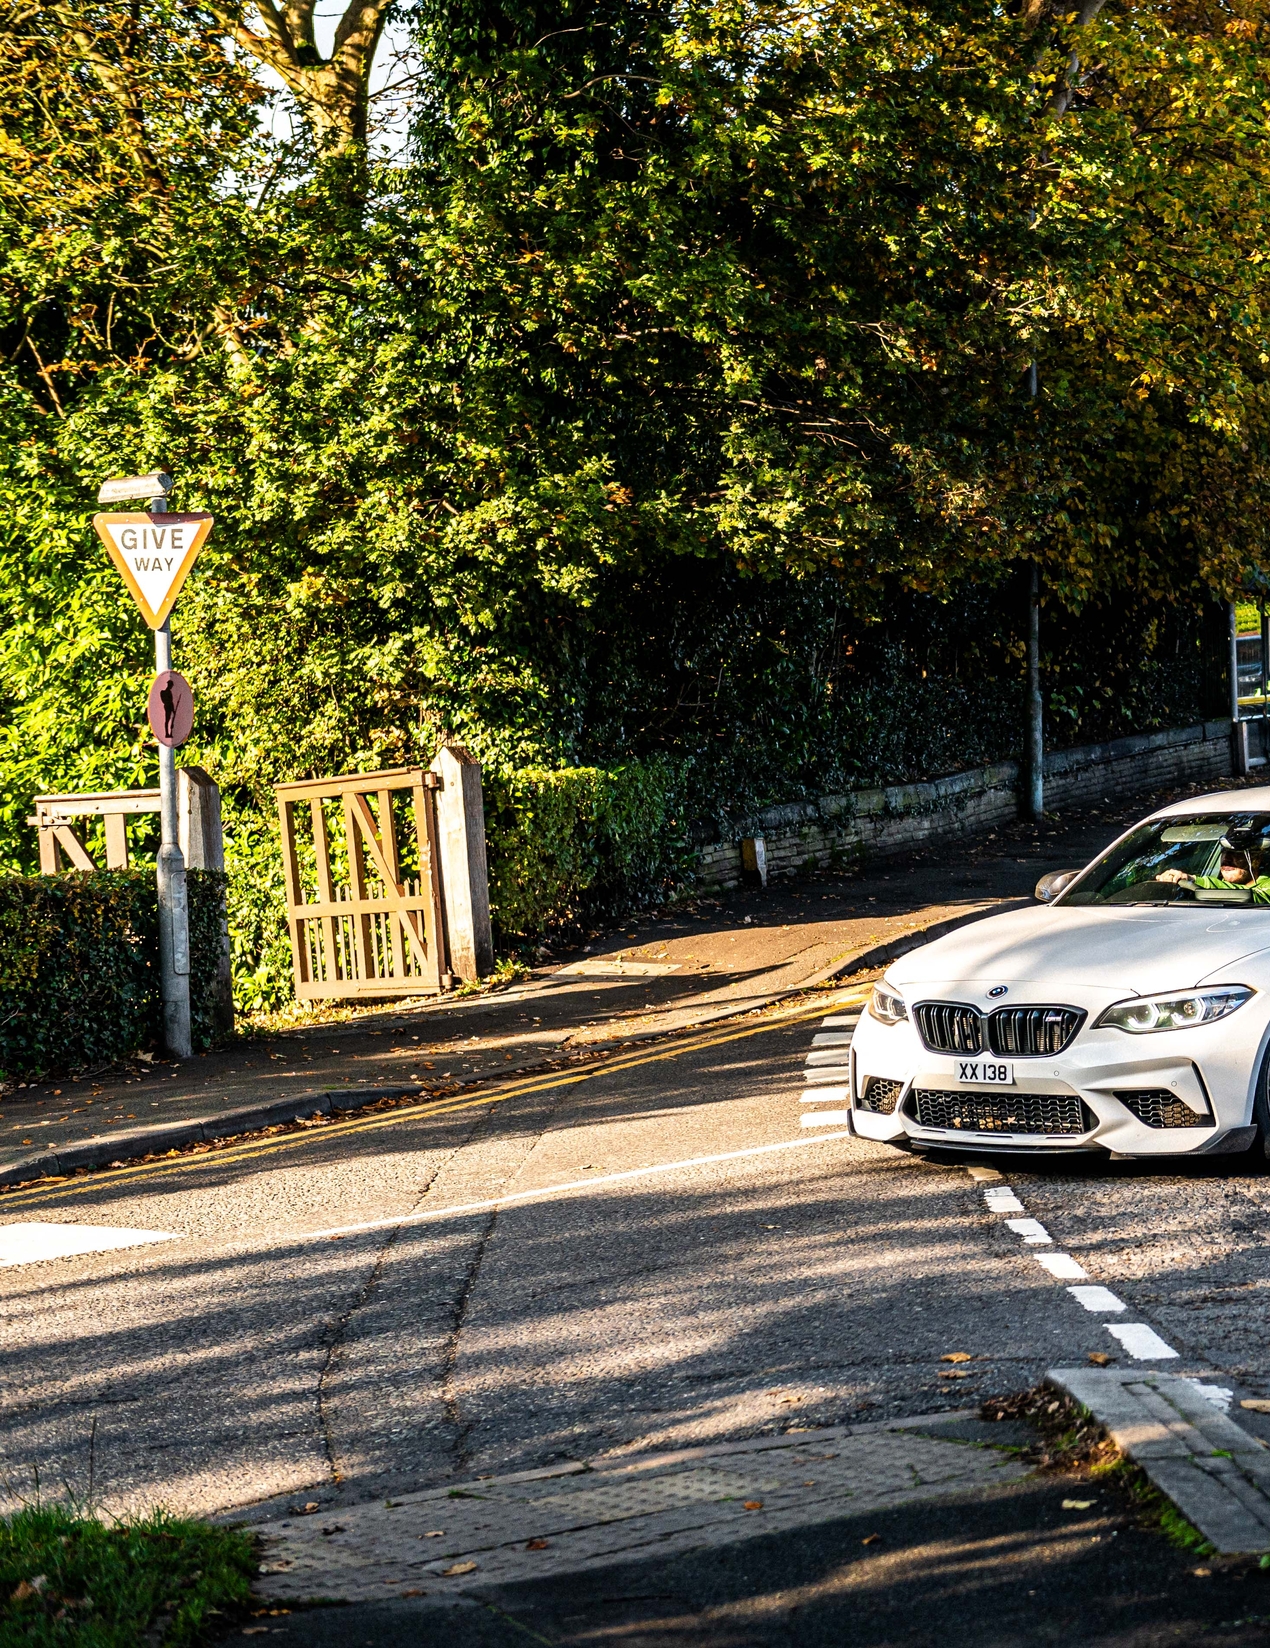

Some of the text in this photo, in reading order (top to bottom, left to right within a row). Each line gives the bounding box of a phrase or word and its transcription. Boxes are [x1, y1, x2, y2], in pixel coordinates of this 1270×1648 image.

[121, 528, 183, 550] GIVE
[134, 557, 174, 571] WAY
[959, 1062, 1007, 1081] XX 138
